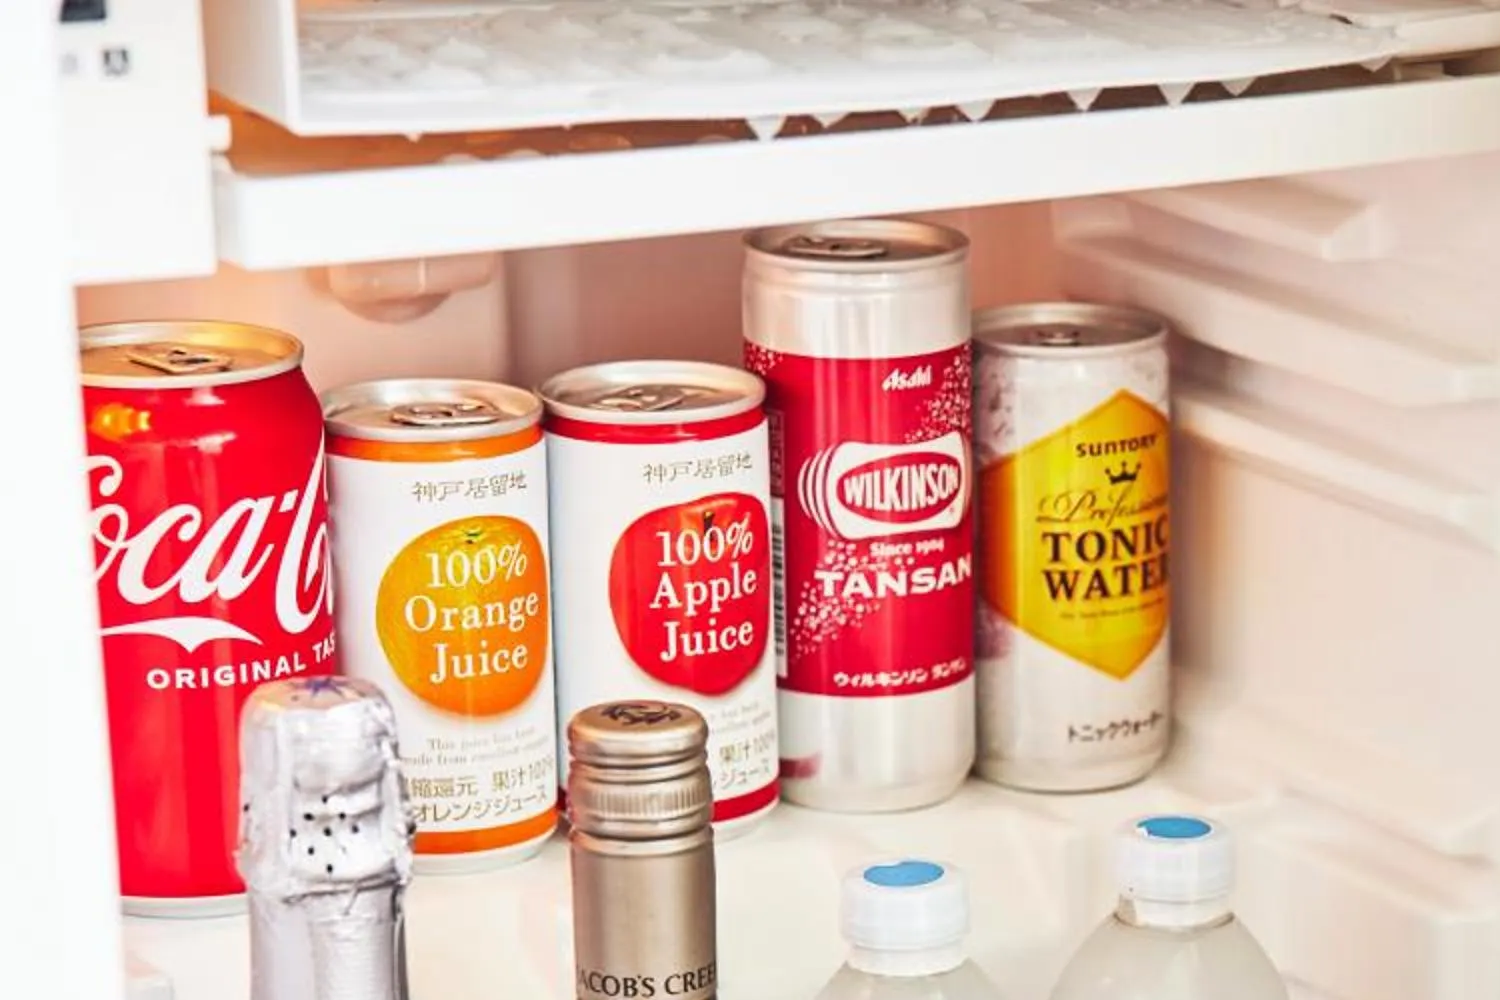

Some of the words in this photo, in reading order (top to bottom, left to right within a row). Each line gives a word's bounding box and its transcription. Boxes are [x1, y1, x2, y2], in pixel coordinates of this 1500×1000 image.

[882, 365, 932, 391] Asahi
[843, 464, 958, 512] WILKINSON
[656, 513, 753, 567] 100%
[870, 542, 913, 557] Since
[426, 540, 527, 589] 100%
[814, 553, 971, 598] TANSAN
[649, 562, 757, 617] Apple
[404, 592, 539, 632] Orange
[660, 618, 753, 662] Juice
[146, 653, 306, 689] ORIGINAL
[430, 641, 528, 684] Juice
[404, 775, 478, 799] 縮還元
